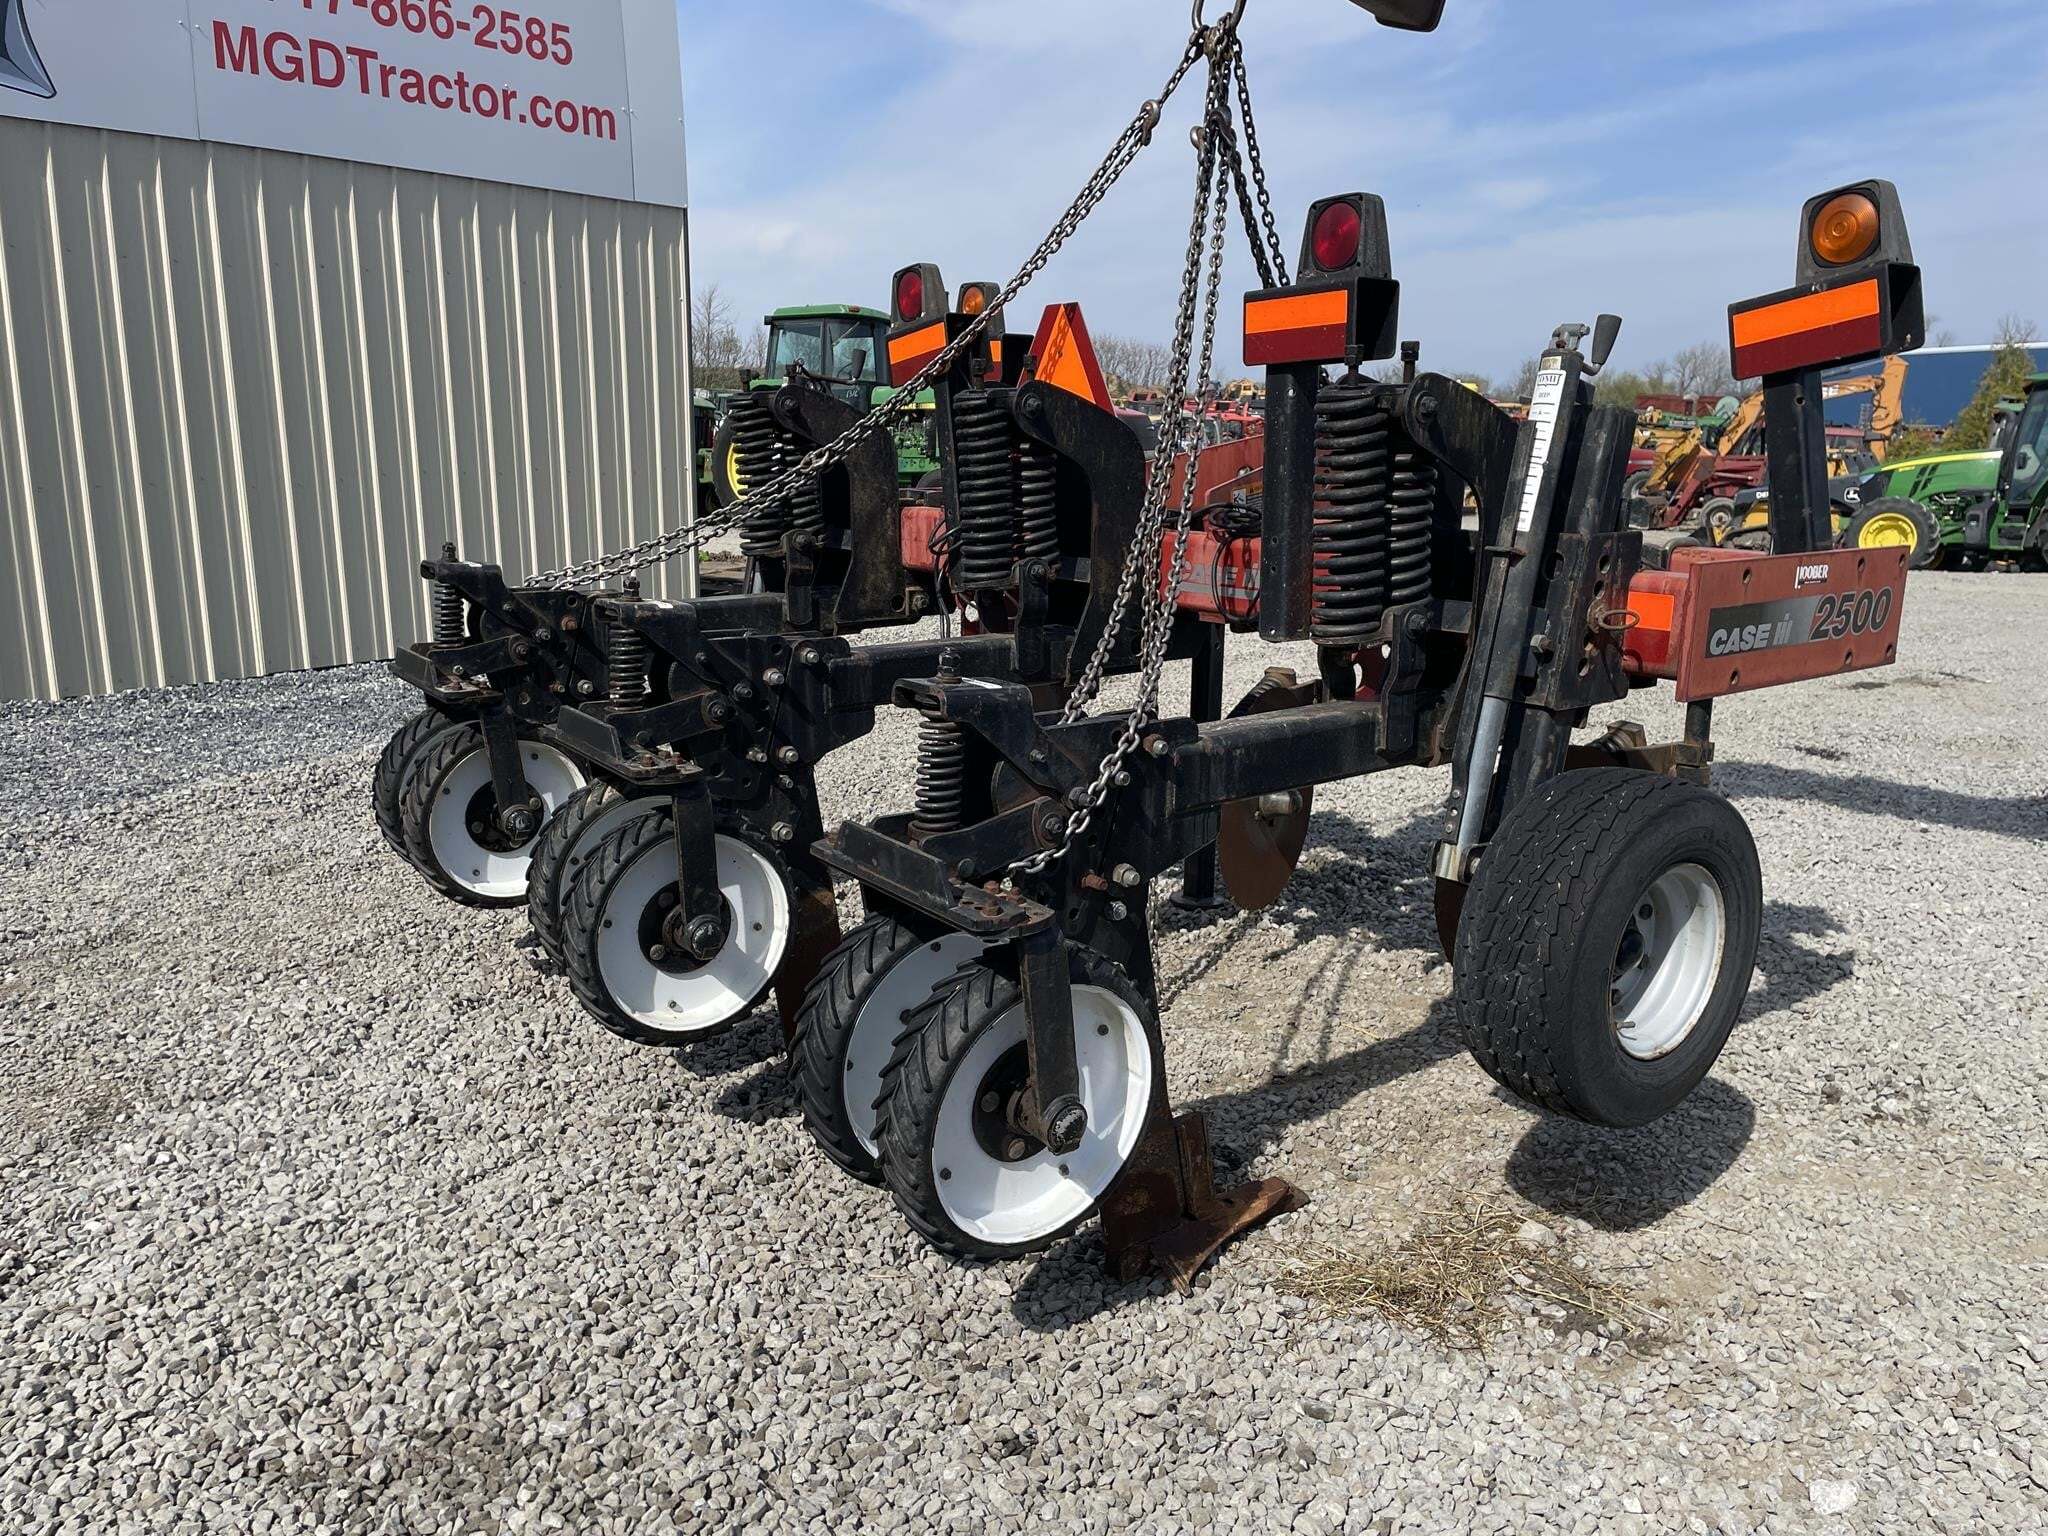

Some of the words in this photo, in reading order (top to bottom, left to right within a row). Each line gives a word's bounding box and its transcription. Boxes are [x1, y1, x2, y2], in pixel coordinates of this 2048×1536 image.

[212, 21, 617, 140] MGDTractor.com
[1709, 622, 1773, 656] CASE
[1807, 585, 1894, 644] 2500
